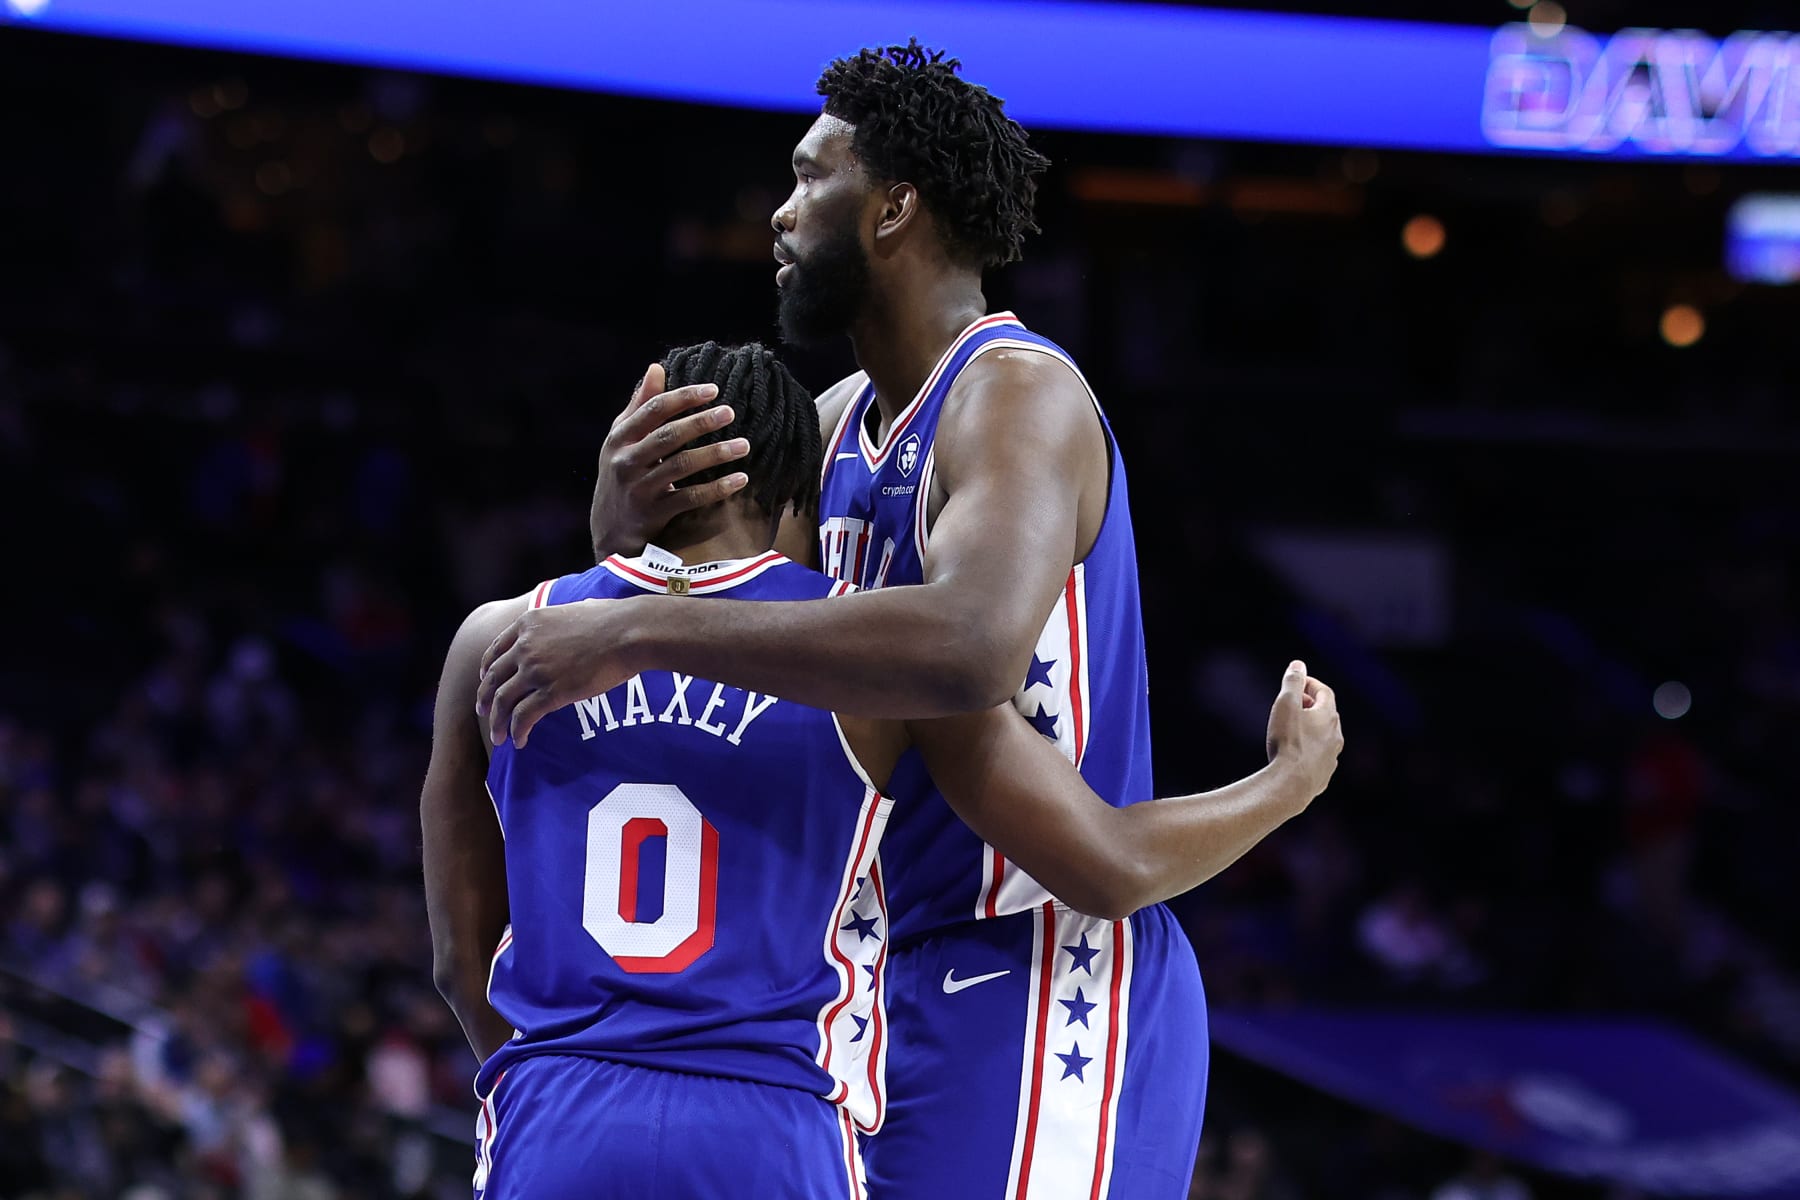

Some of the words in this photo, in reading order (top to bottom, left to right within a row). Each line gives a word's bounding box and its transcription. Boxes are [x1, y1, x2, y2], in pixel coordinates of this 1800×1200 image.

[882, 485, 915, 497] crypto.co
[574, 672, 779, 746] MAXEY
[582, 783, 719, 973] 0
